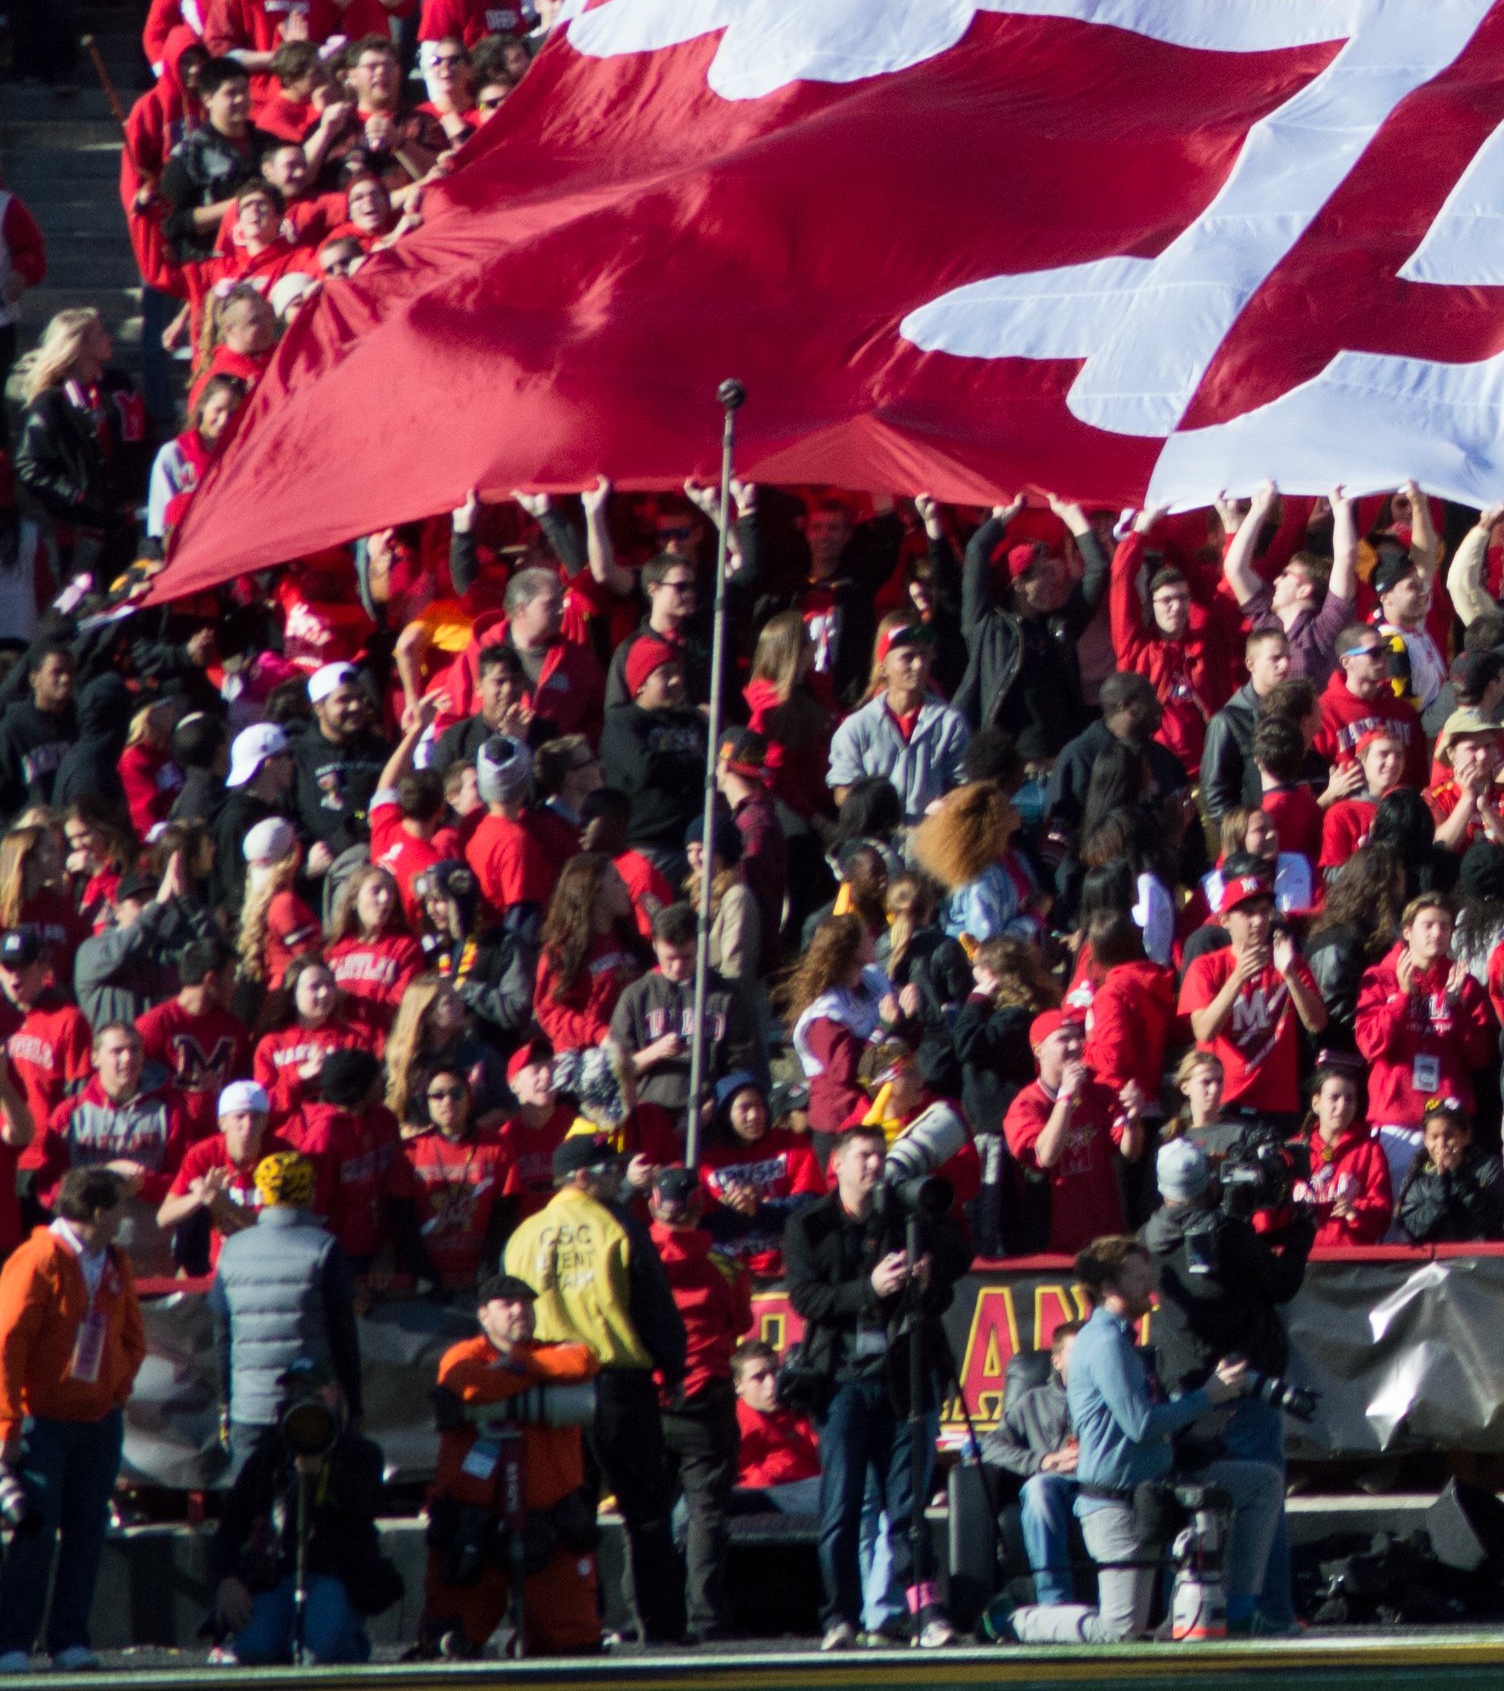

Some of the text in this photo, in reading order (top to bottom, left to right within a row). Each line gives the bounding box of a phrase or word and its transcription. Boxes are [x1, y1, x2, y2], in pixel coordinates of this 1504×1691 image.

[1231, 993, 1270, 1031] M
[172, 1034, 239, 1087] M
[540, 1222, 593, 1247] CSC
